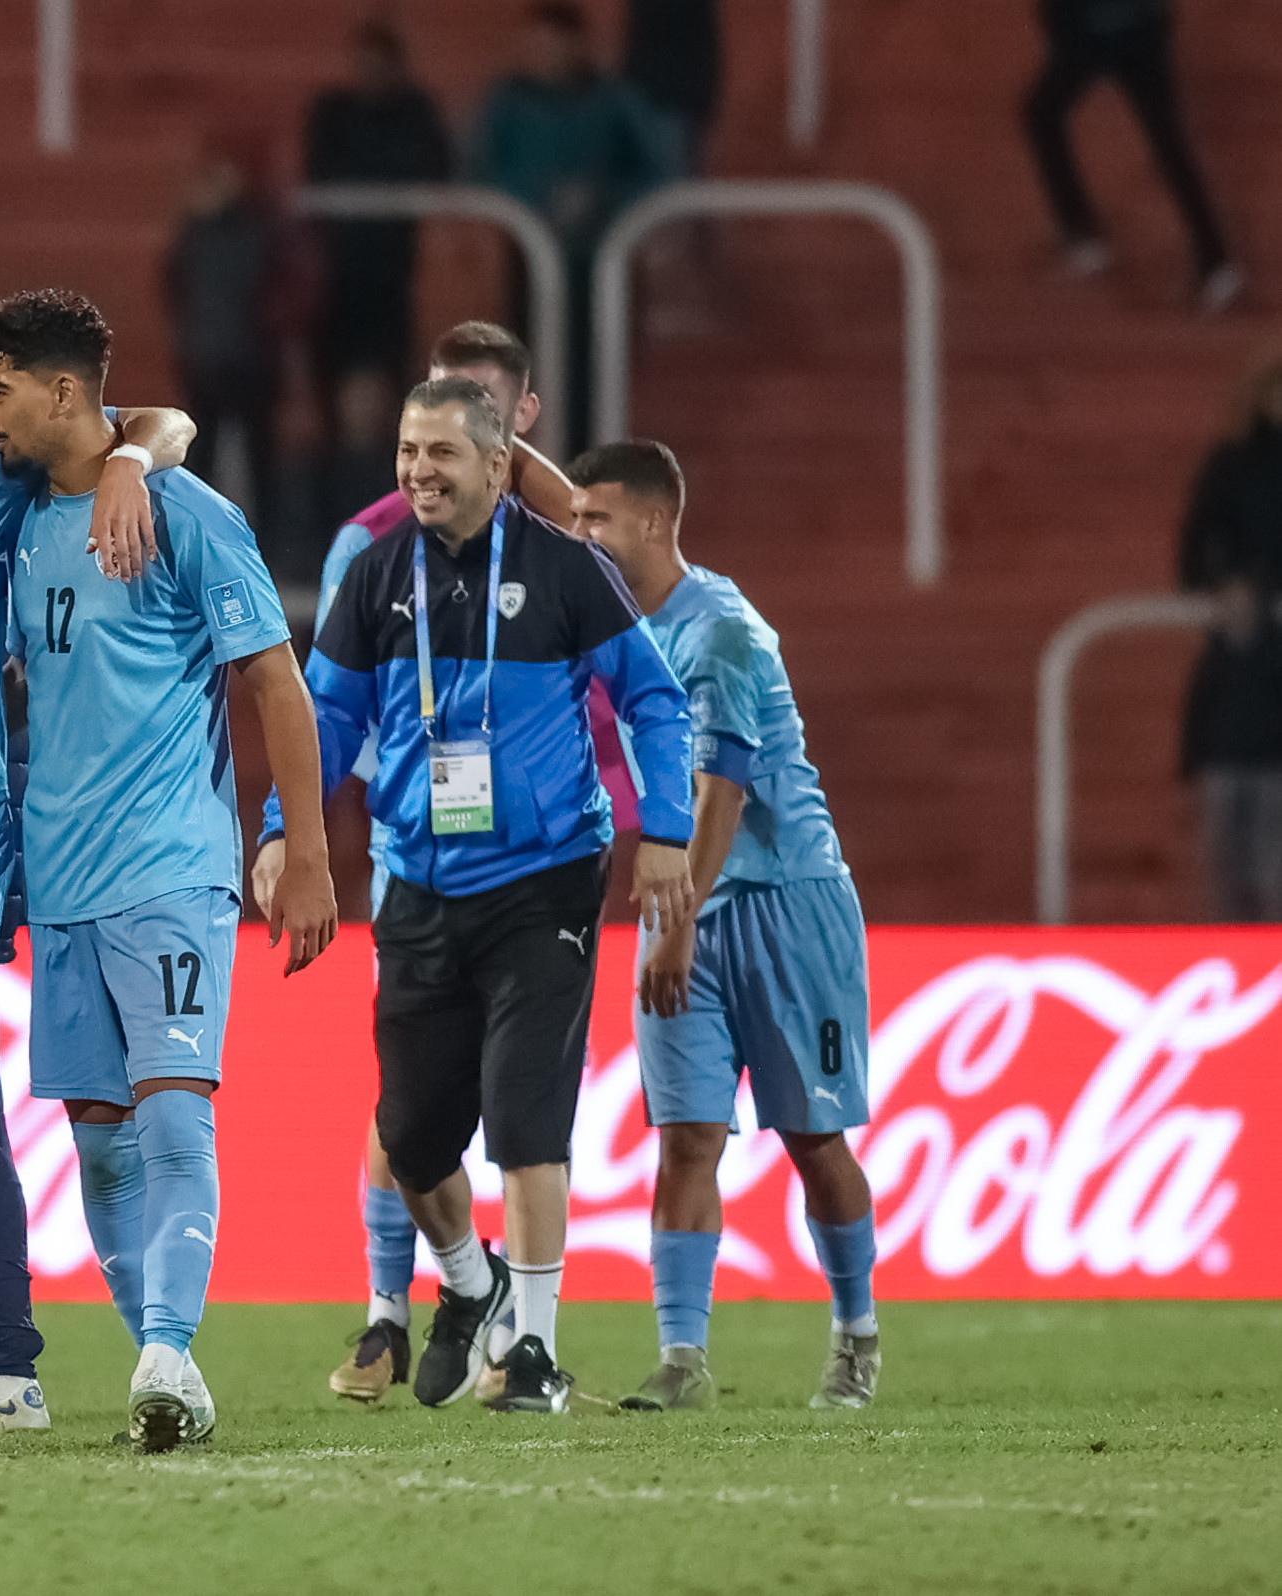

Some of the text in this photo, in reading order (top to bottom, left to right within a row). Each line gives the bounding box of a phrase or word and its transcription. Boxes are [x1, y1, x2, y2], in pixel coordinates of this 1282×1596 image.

[45, 587, 76, 654] 12
[158, 951, 205, 1017] 12
[818, 1018, 843, 1077] 8
